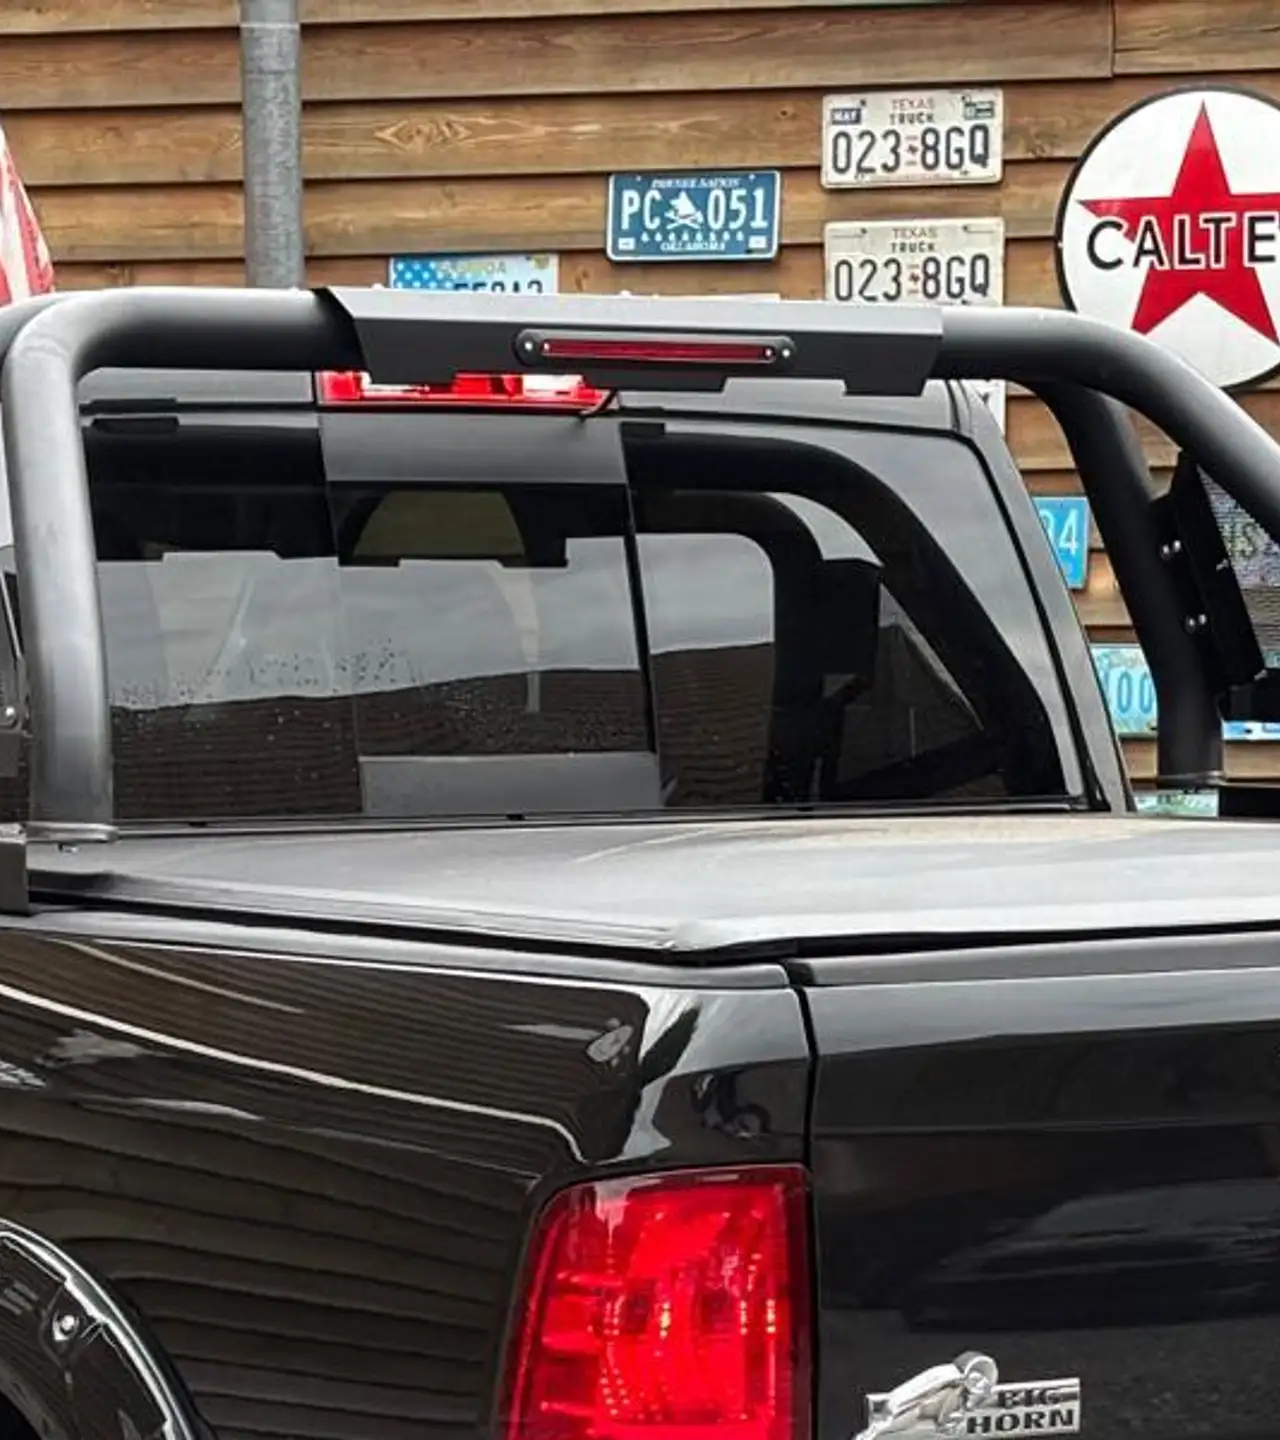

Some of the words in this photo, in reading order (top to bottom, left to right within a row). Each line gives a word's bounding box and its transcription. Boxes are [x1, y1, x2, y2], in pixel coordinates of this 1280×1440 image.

[889, 111, 935, 125] TRUCK
[891, 226, 938, 240] TEXAS
[890, 240, 936, 254] TRUCK
[996, 1386, 1056, 1410] BIG
[966, 1408, 1074, 1435] HORN
